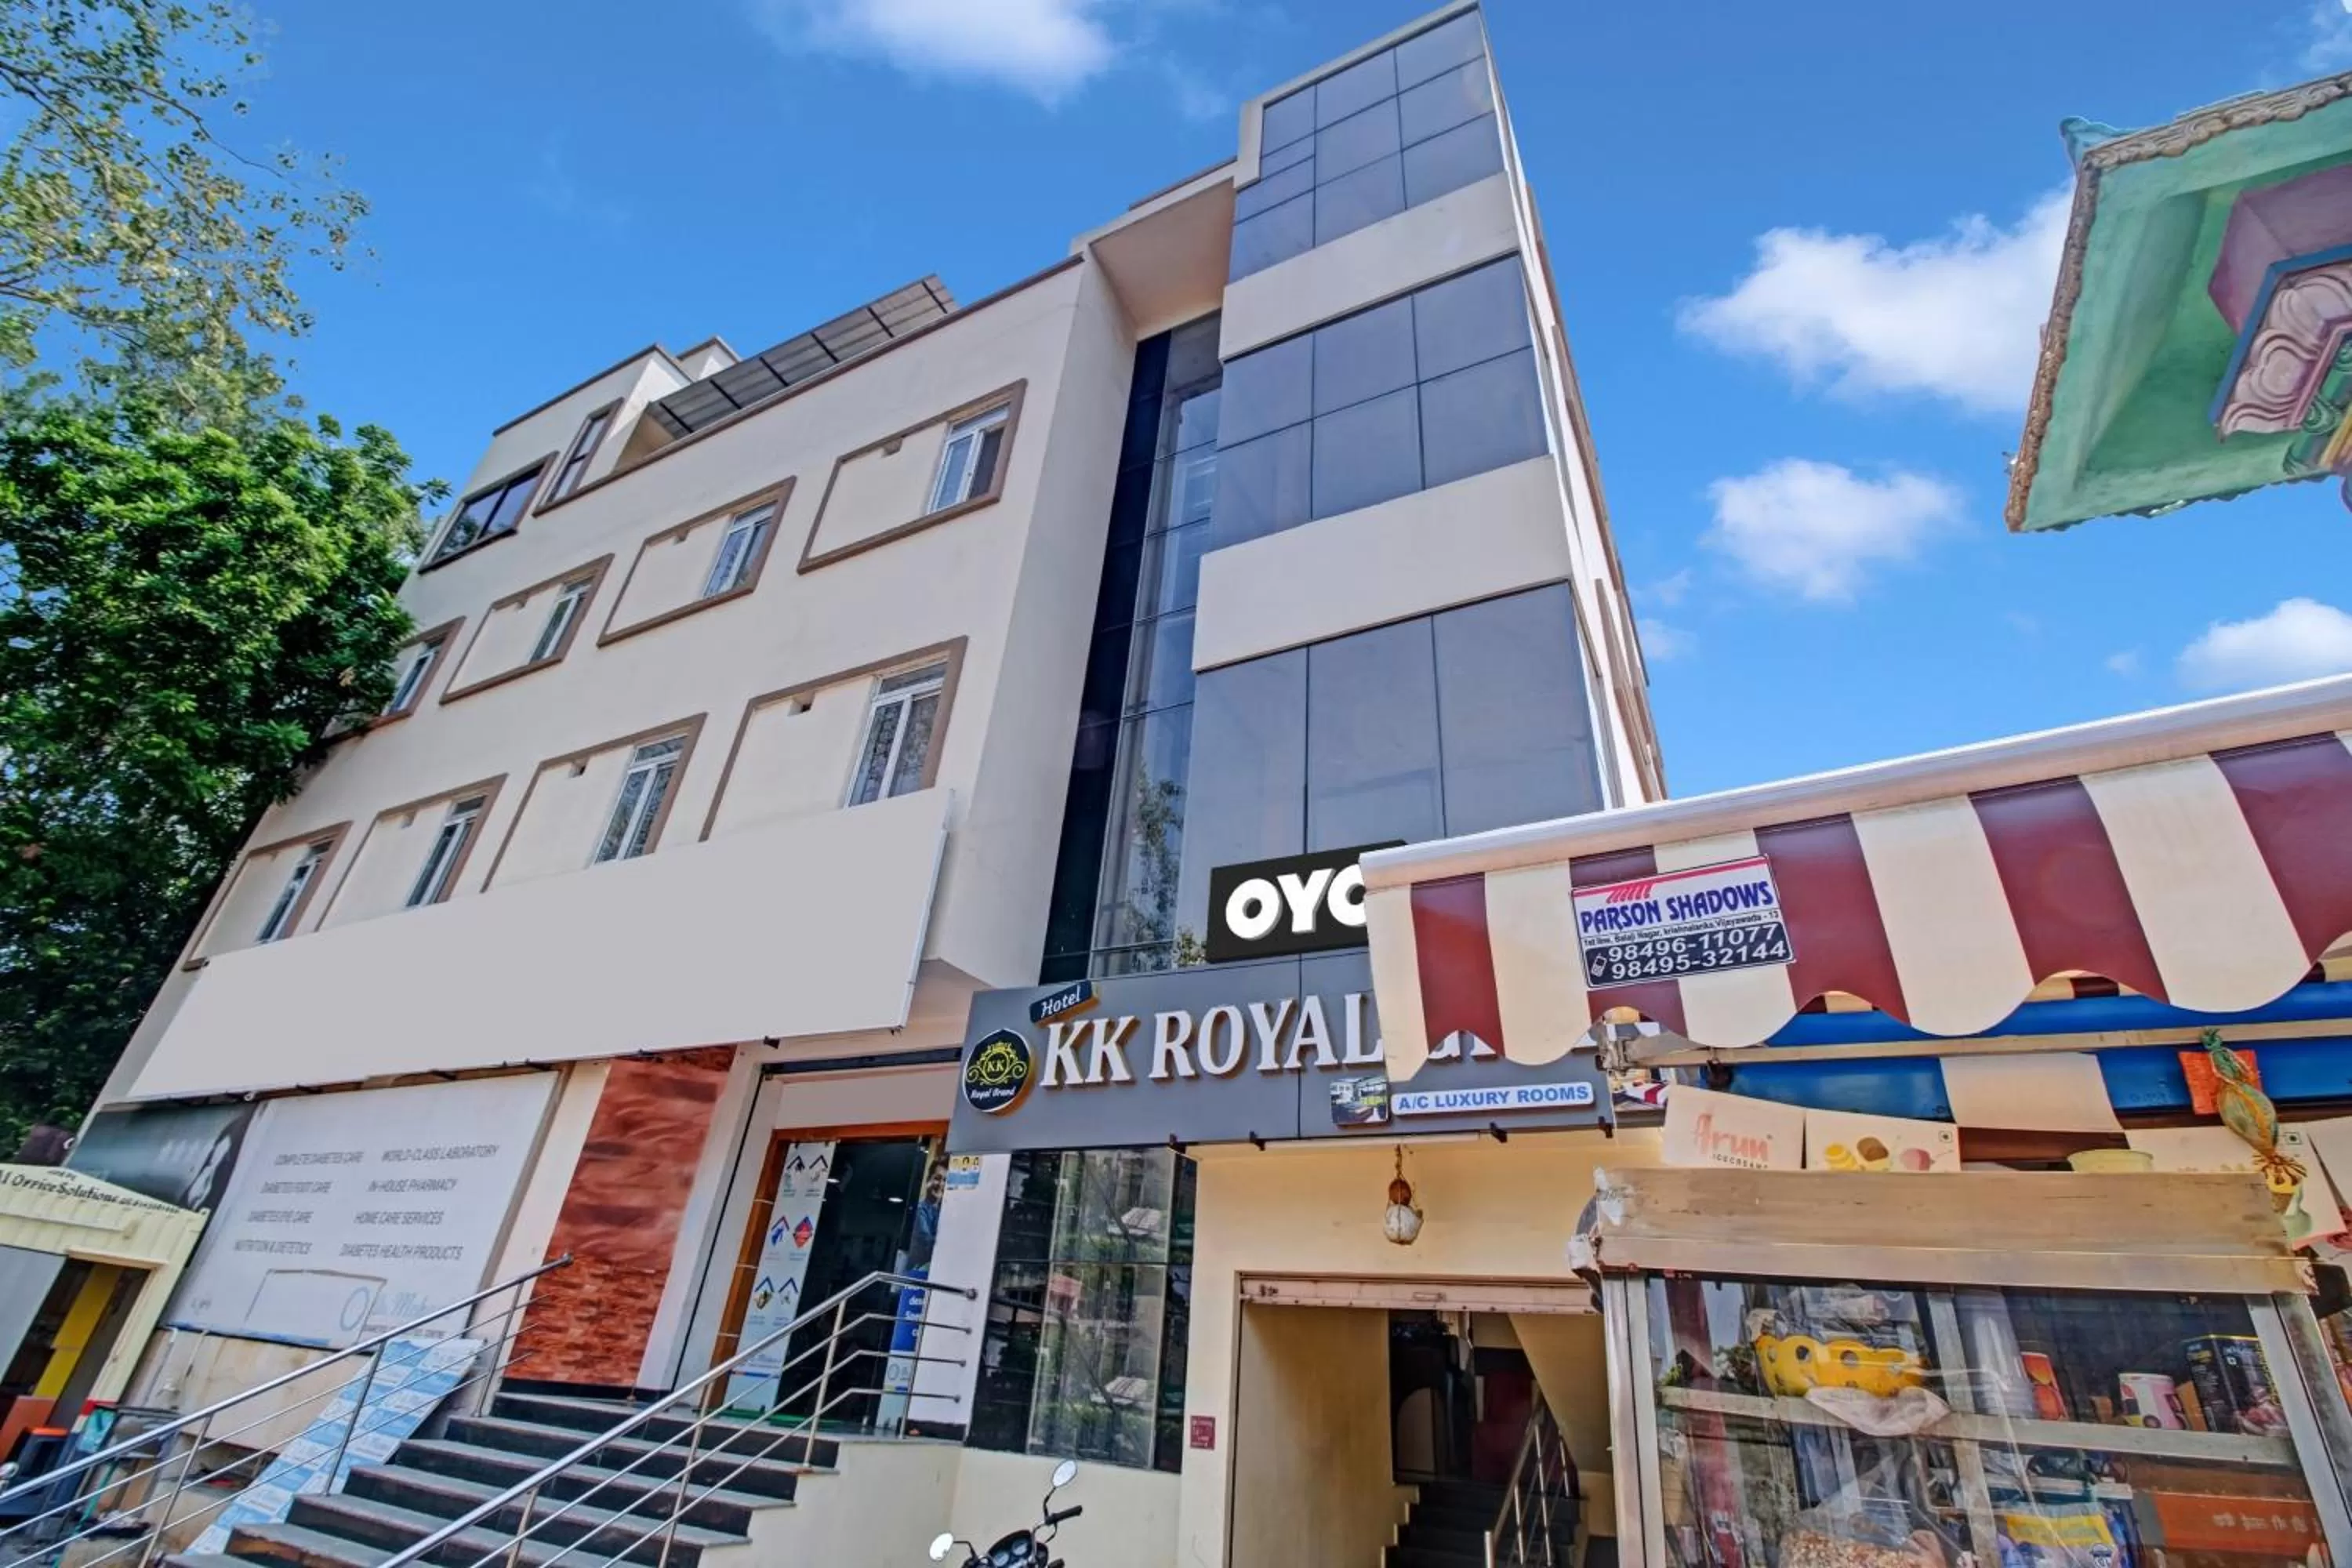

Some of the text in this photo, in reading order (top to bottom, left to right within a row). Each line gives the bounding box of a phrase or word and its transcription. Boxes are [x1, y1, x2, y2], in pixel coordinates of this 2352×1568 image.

[1225, 863, 1367, 940] OYO
[1581, 881, 1774, 933] PARSON SHADOWS
[1609, 924, 1778, 962] 98496-11077
[1612, 940, 1787, 980] 98495-32144
[1040, 985, 1080, 1018] Hotel
[1039, 993, 1386, 1088] KK ROYAL
[986, 1059, 1006, 1073] KK
[1398, 1085, 1590, 1110] A/C LUXURY ROOMS
